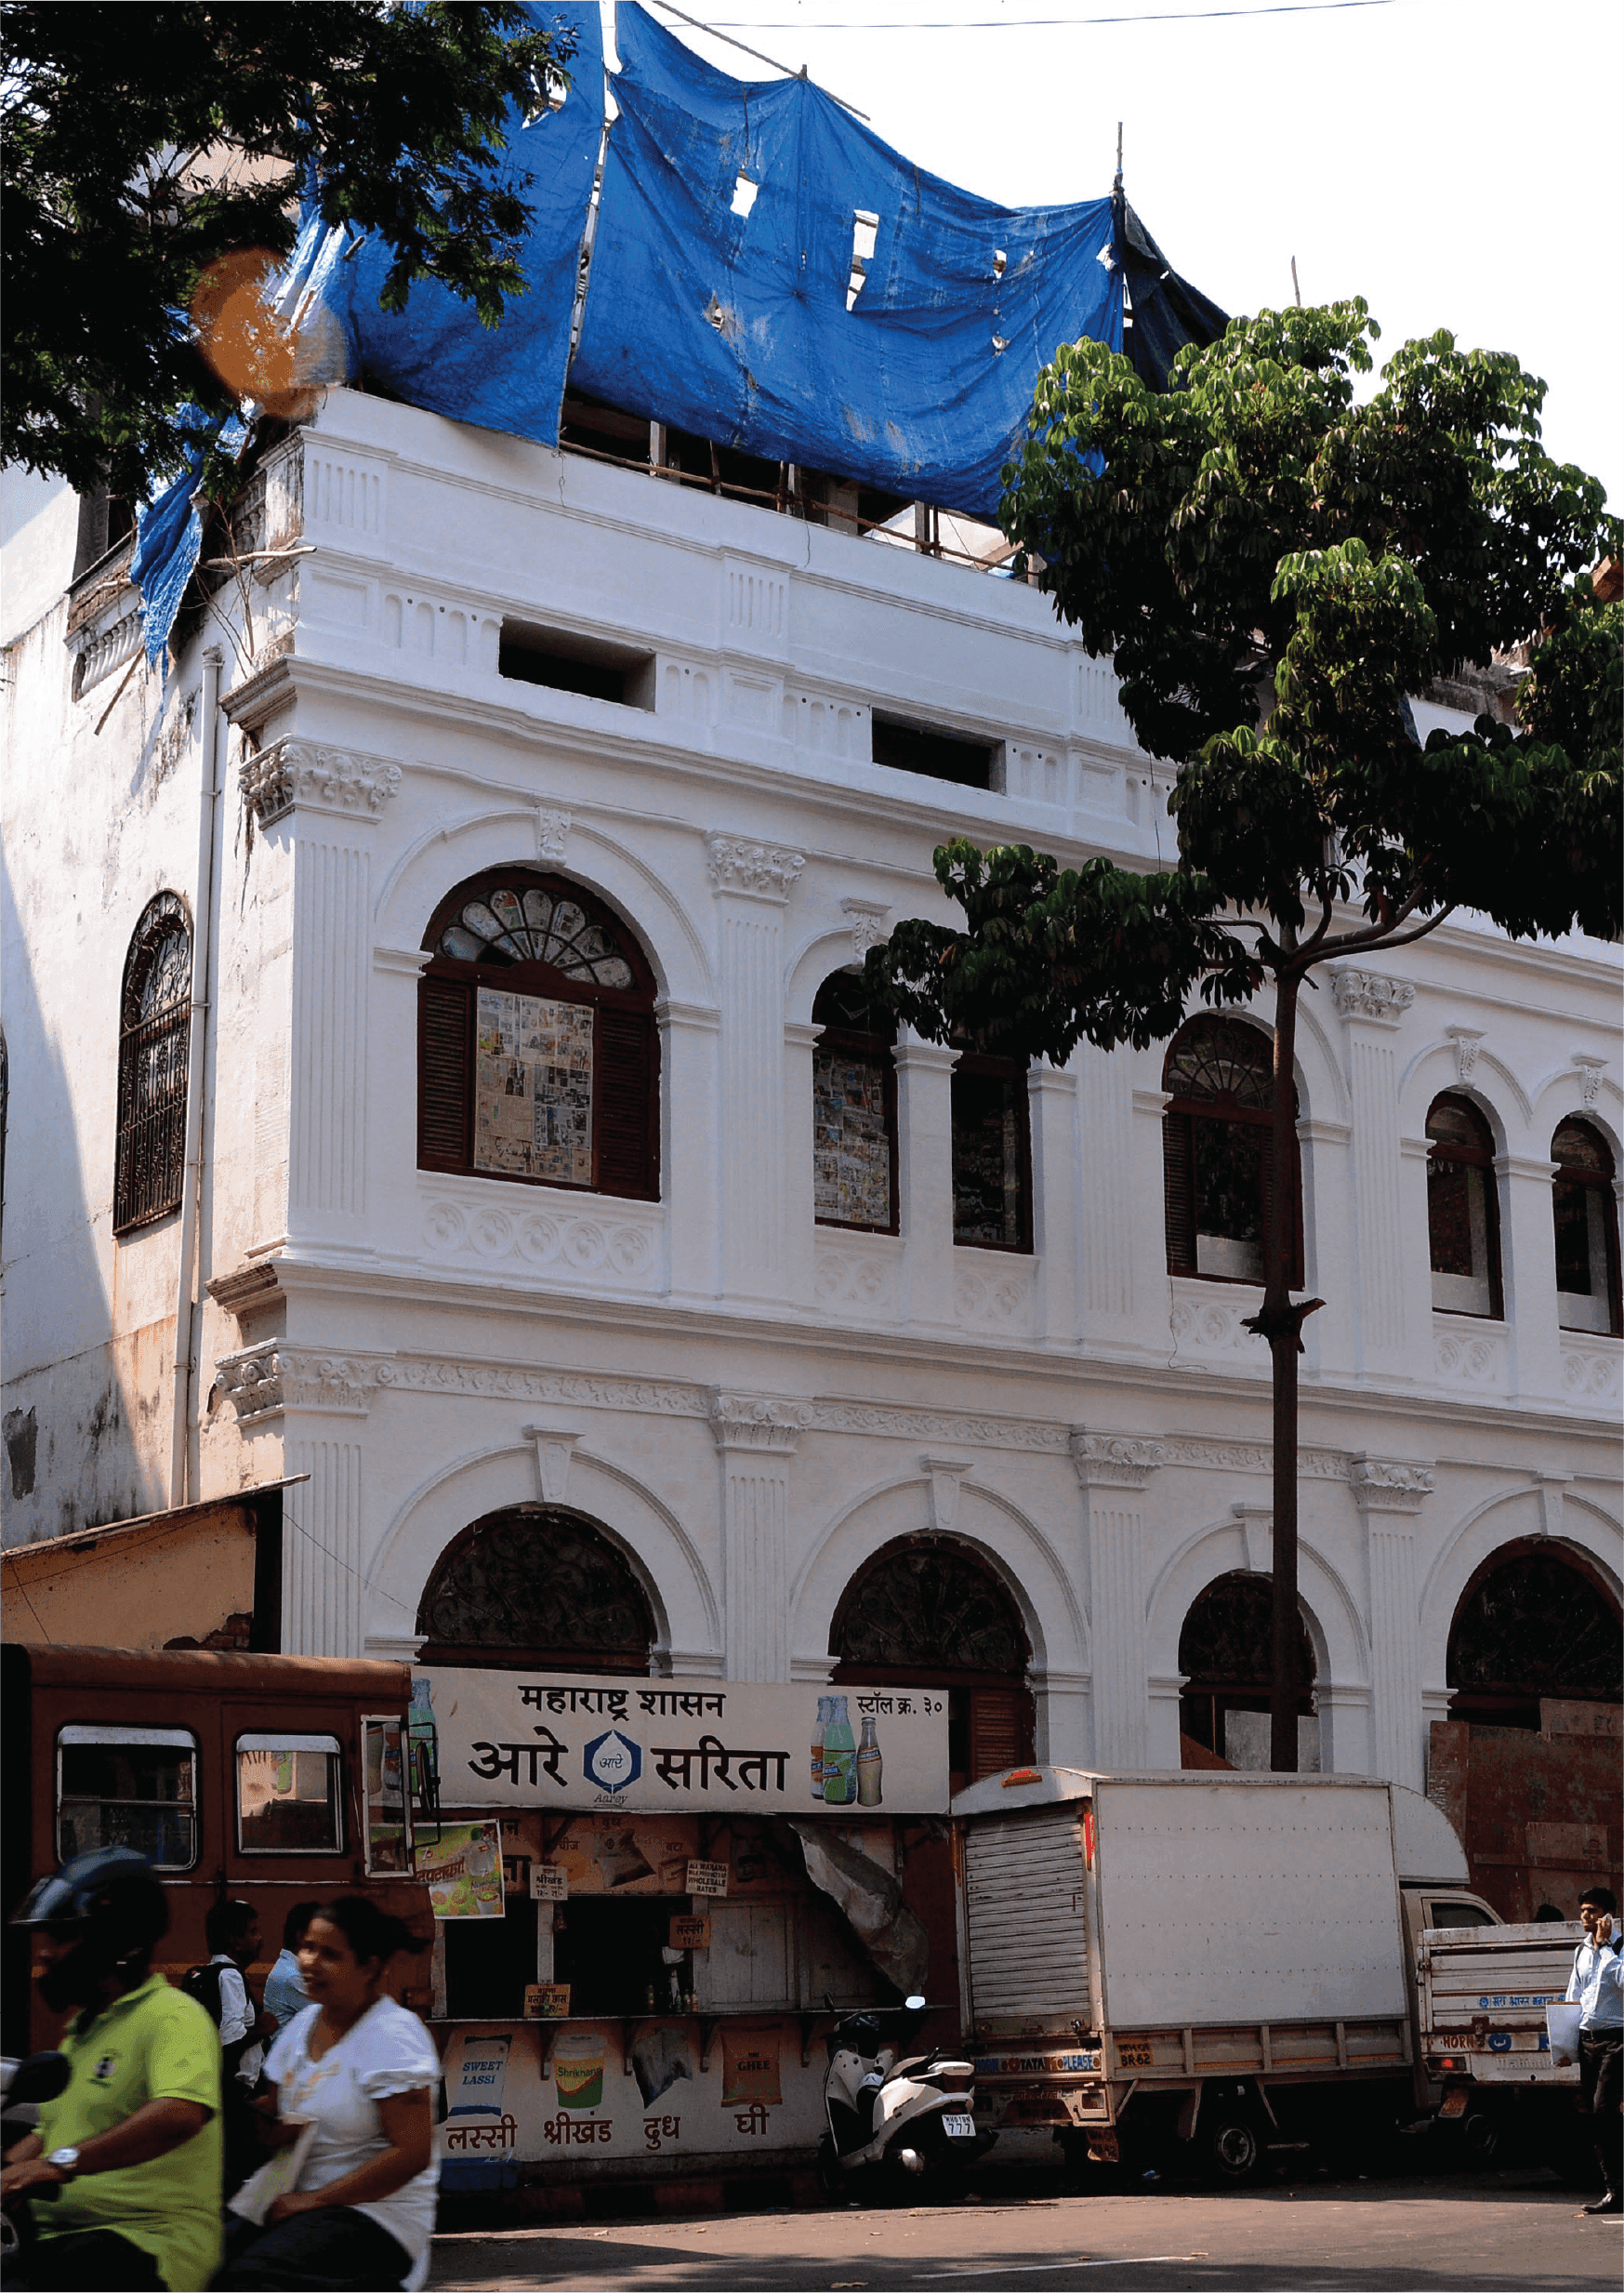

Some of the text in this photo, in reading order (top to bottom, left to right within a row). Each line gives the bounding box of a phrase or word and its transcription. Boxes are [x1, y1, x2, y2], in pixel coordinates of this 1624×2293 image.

[518, 1685, 726, 1721] महाराष्ट्र शासन
[856, 1691, 943, 1716] स्टॉल क्र. ३०
[468, 1725, 791, 1791] आरे सरिता
[600, 1753, 624, 1769] आरे
[594, 1793, 628, 1805] Aarey
[688, 1877, 726, 1887] WHOLESALE
[1443, 2035, 1473, 2048] HORN
[463, 2061, 503, 2072] SWEET
[738, 2061, 770, 2072] GHEE
[1021, 2057, 1045, 2071] TATA
[1063, 2055, 1092, 2070] PLEASE
[463, 2075, 495, 2085] LASSI
[734, 2102, 770, 2135] घी
[446, 2114, 518, 2150] लस्सी
[544, 2111, 613, 2144] श्रीखंड
[948, 2123, 970, 2135] 777
